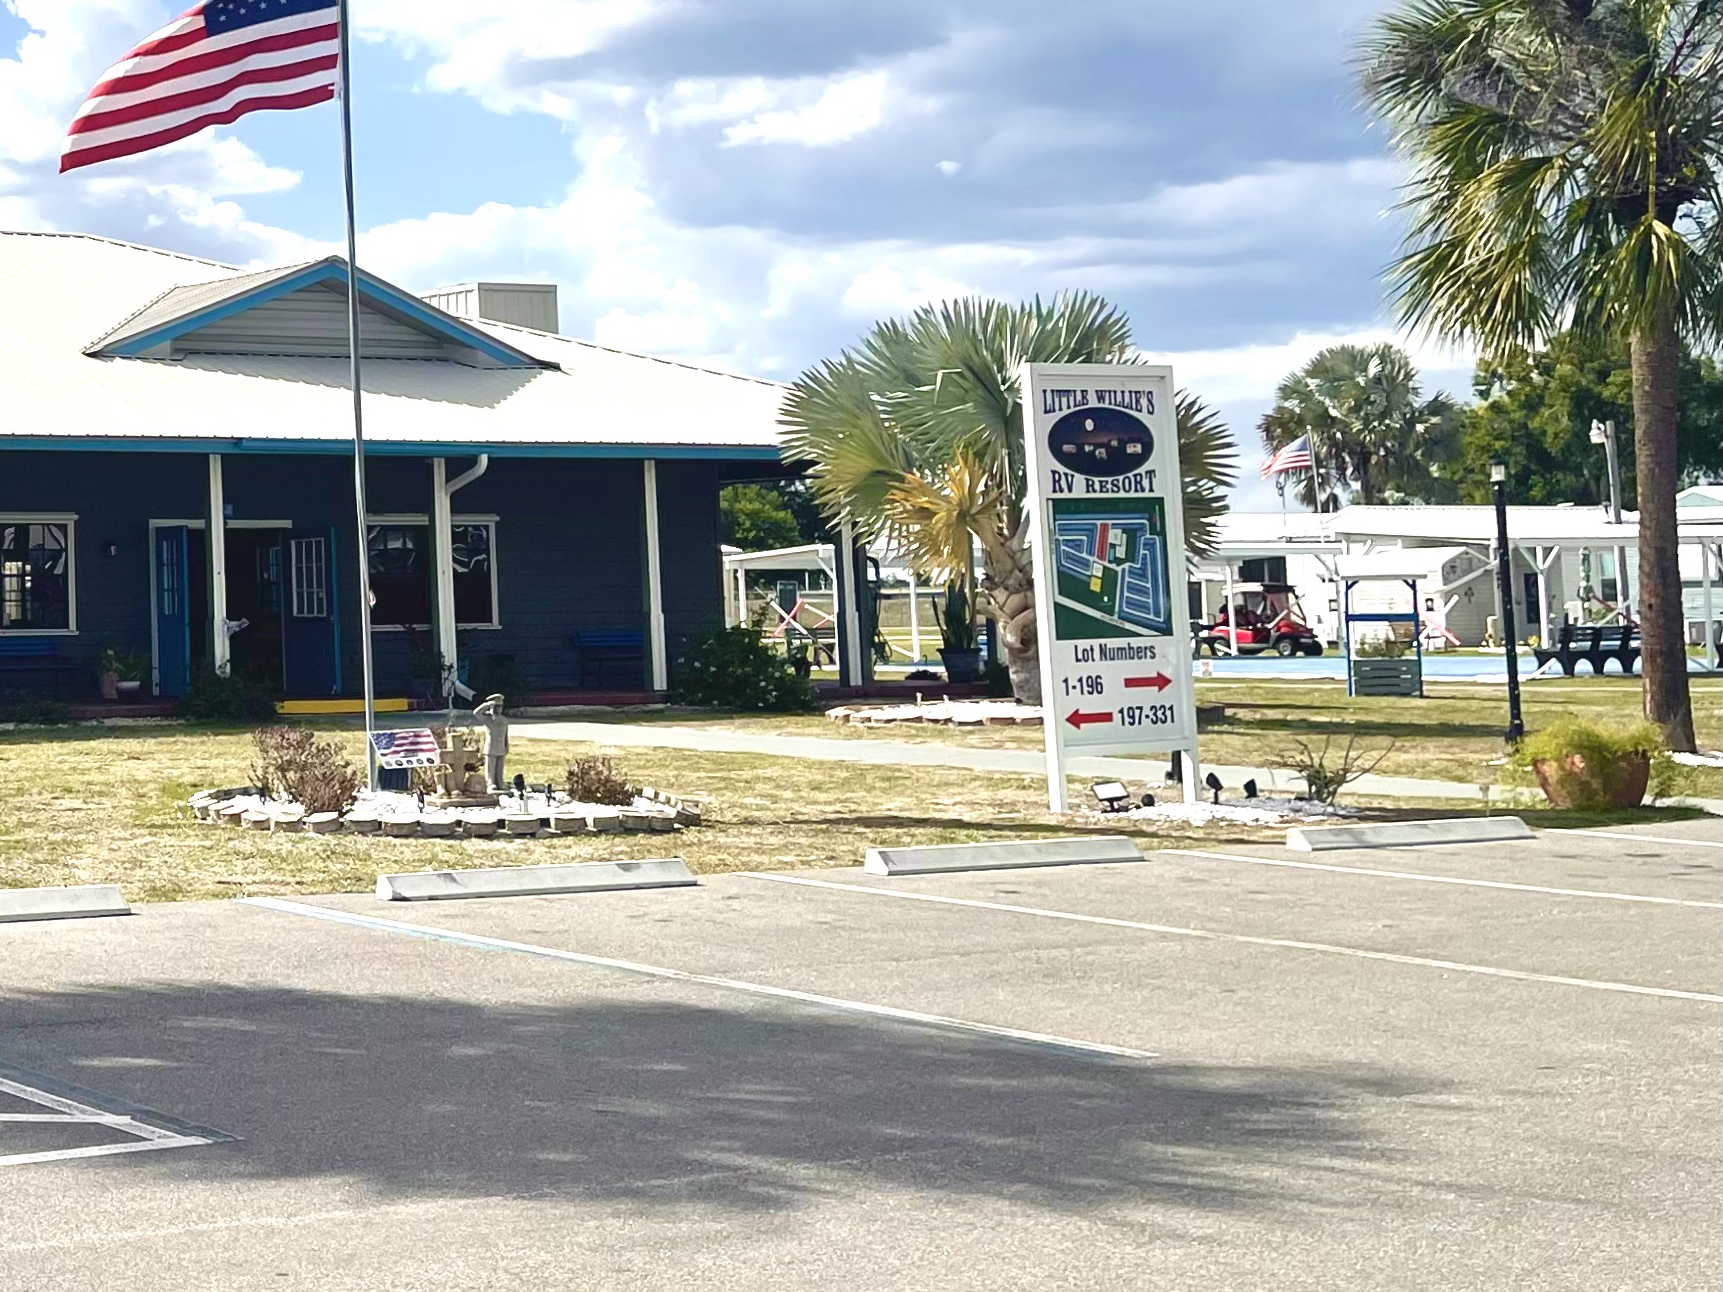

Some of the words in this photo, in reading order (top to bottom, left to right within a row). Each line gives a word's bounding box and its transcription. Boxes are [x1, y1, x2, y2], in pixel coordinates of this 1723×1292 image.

[1042, 389, 1089, 414] LITTLE
[1094, 389, 1155, 416] WILLIE'S
[1051, 469, 1075, 493] RV
[1084, 469, 1156, 493] RESORT
[1074, 645, 1096, 663] Lot
[1099, 642, 1157, 662] Numbers
[1062, 675, 1104, 696] 1-196
[1118, 704, 1175, 726] 197-331
